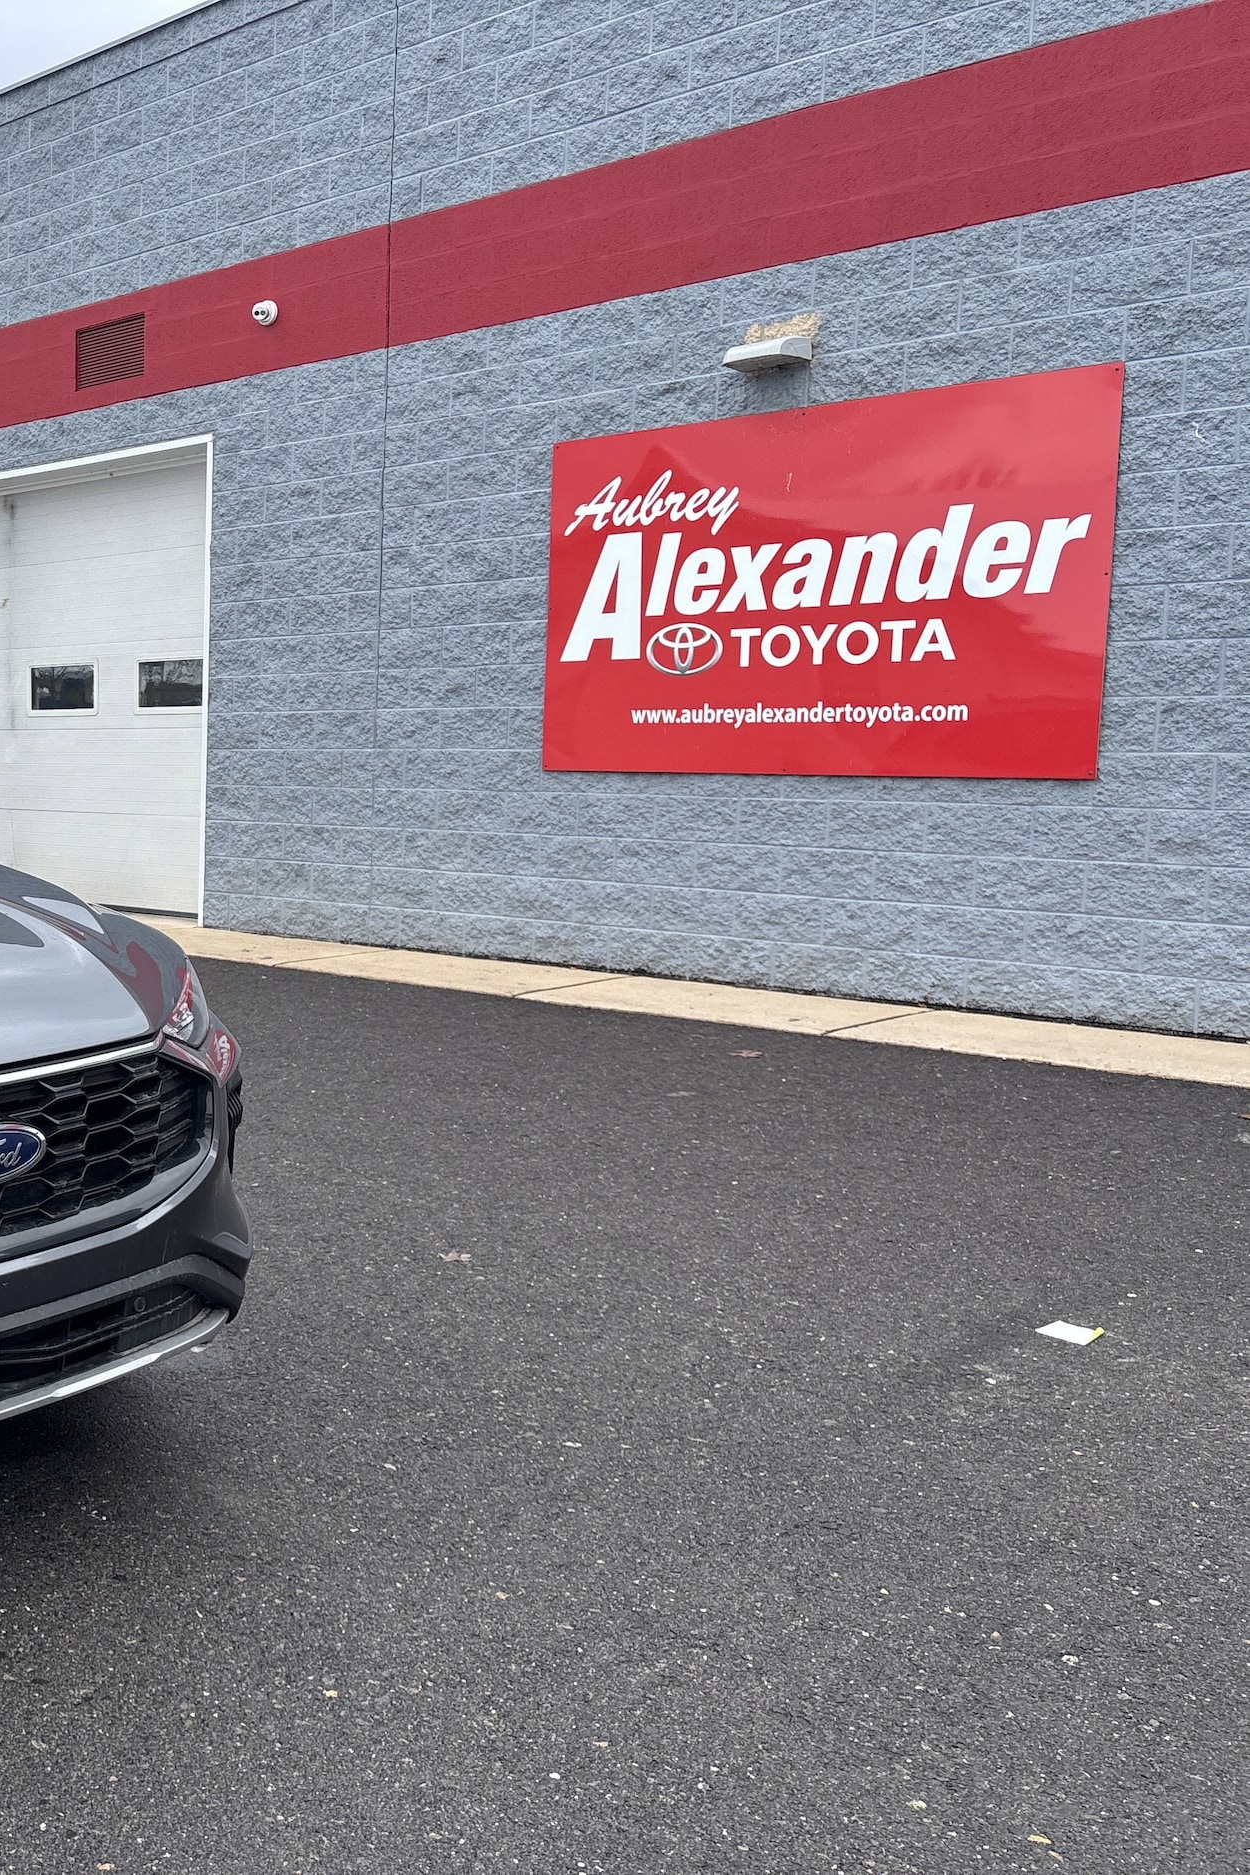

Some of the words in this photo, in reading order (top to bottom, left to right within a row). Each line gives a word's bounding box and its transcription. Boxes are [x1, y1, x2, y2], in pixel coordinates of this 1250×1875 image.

[564, 469, 740, 537] Aubrey
[560, 503, 1092, 663] Alexander
[730, 618, 956, 668] TOYOTA
[631, 702, 969, 729] www.aubreyalexandertoyota.com
